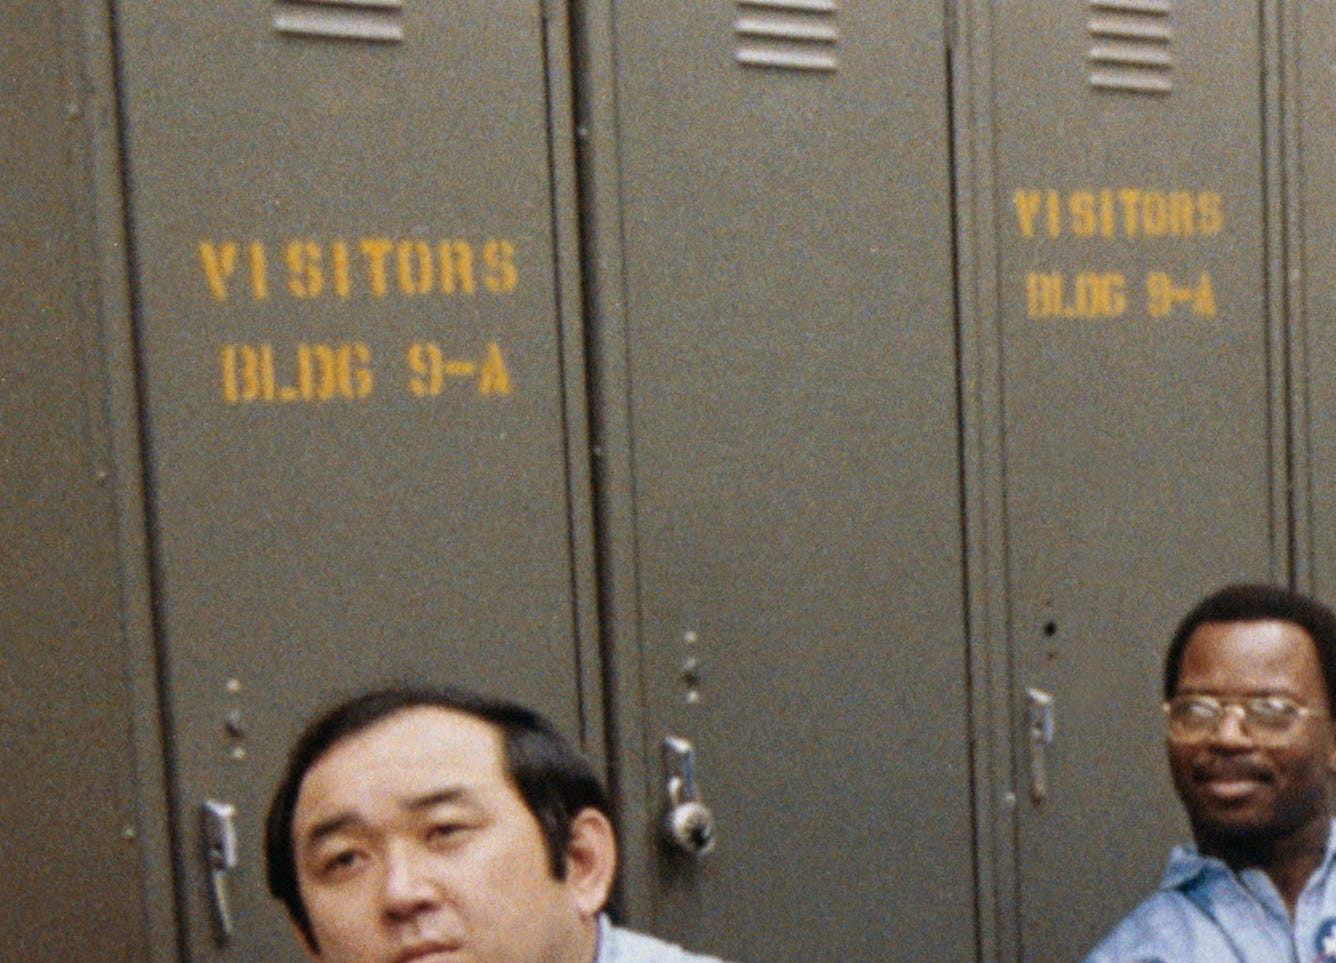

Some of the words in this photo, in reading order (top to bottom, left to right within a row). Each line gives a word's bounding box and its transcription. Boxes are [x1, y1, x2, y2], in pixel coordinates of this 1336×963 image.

[1014, 189, 1222, 238] VISITORS
[199, 238, 517, 300] VISITORS
[1026, 271, 1125, 317] BLDG
[1148, 271, 1216, 317] 9-A
[220, 342, 373, 401] BLDG
[406, 341, 511, 396] 9-A
